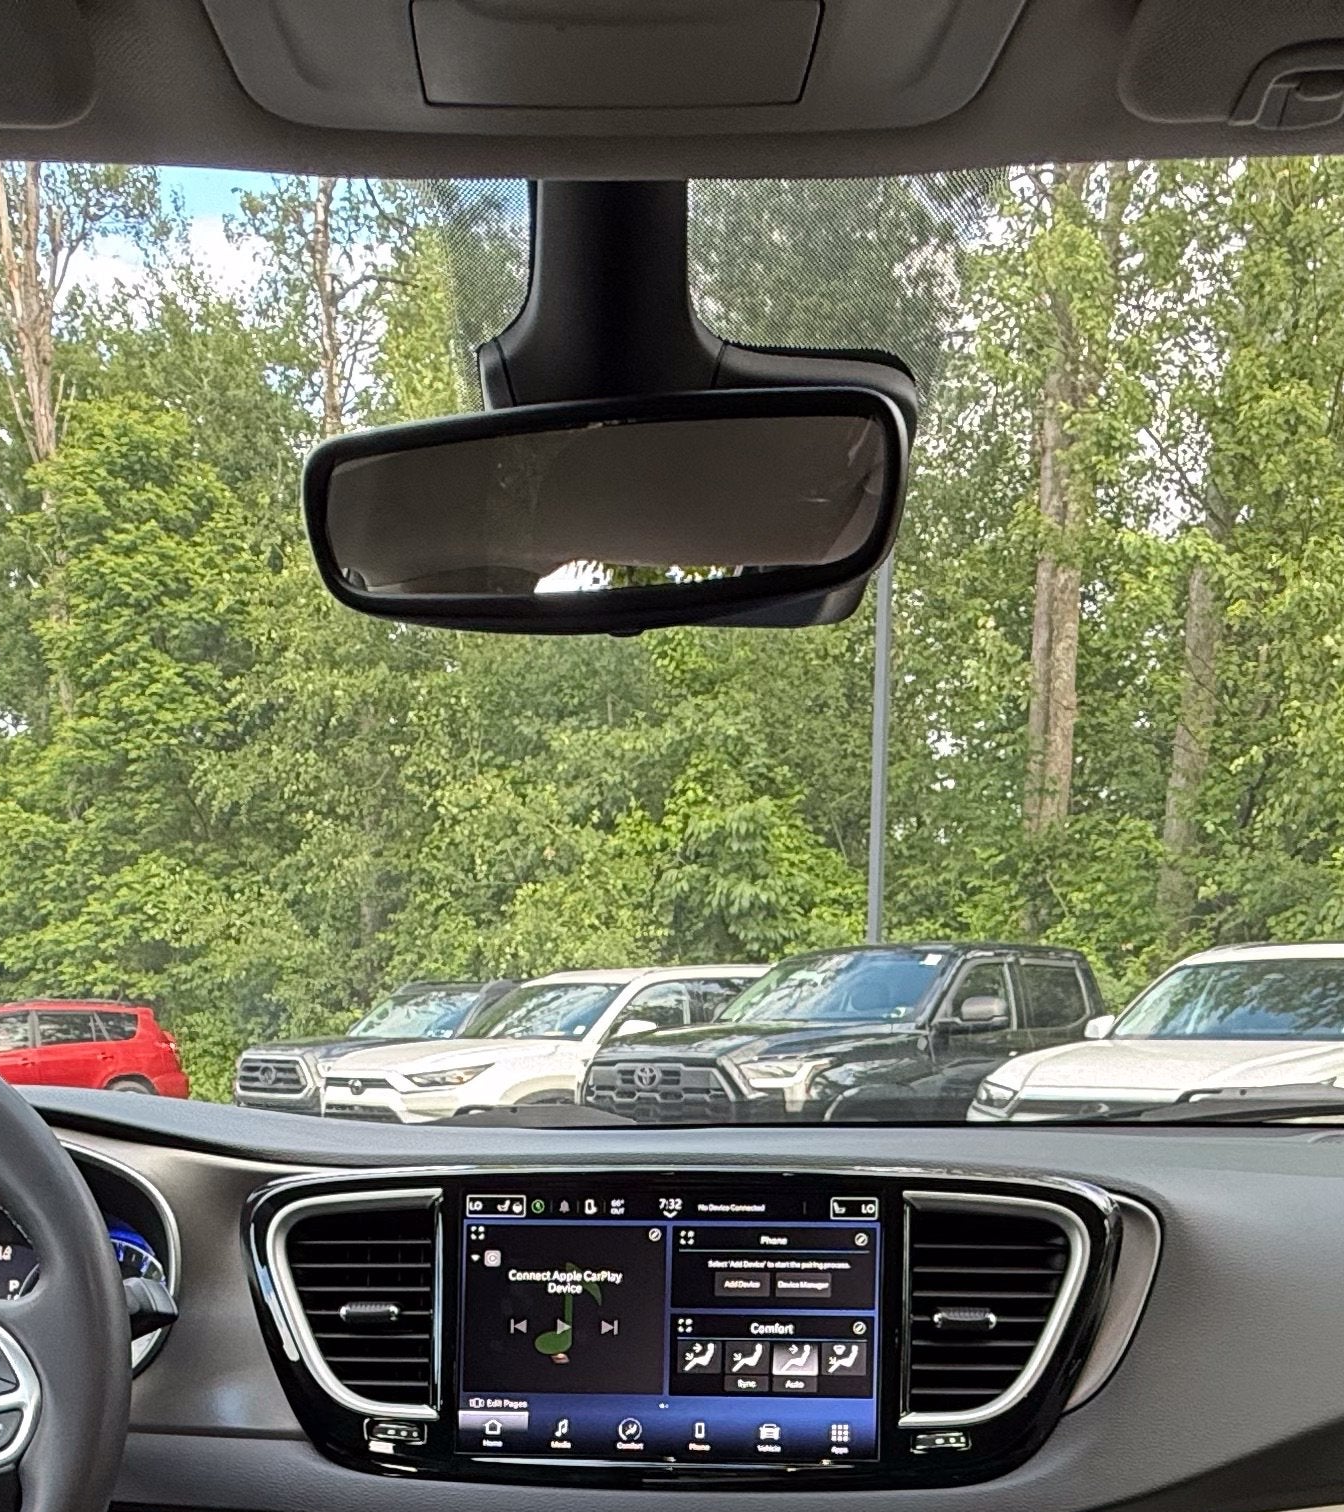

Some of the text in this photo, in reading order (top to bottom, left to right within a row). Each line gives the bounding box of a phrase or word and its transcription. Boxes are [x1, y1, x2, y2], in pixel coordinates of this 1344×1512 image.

[658, 1198, 683, 1210] 7:32
[697, 1204, 766, 1212] No Device Connected
[861, 1204, 875, 1213] LO
[759, 1236, 788, 1245] Phone
[707, 1260, 728, 1268] Select
[774, 1261, 790, 1269] start
[801, 1262, 823, 1270] pairing
[508, 1269, 623, 1284] Connect Apple CarPlay
[9, 1280, 20, 1292] P
[547, 1283, 583, 1294] Device
[724, 1280, 761, 1289] Add Device
[777, 1280, 829, 1291] Device Manager
[750, 1322, 794, 1335] Comfort
[785, 1379, 805, 1389] Auto
[487, 1399, 528, 1410] Edit Pages
[482, 1439, 503, 1447] Home
[550, 1440, 571, 1449] Media
[616, 1442, 644, 1450] Comfort
[688, 1443, 711, 1451] Phone
[756, 1444, 781, 1453] Vehicle
[831, 1446, 849, 1455] Apps
